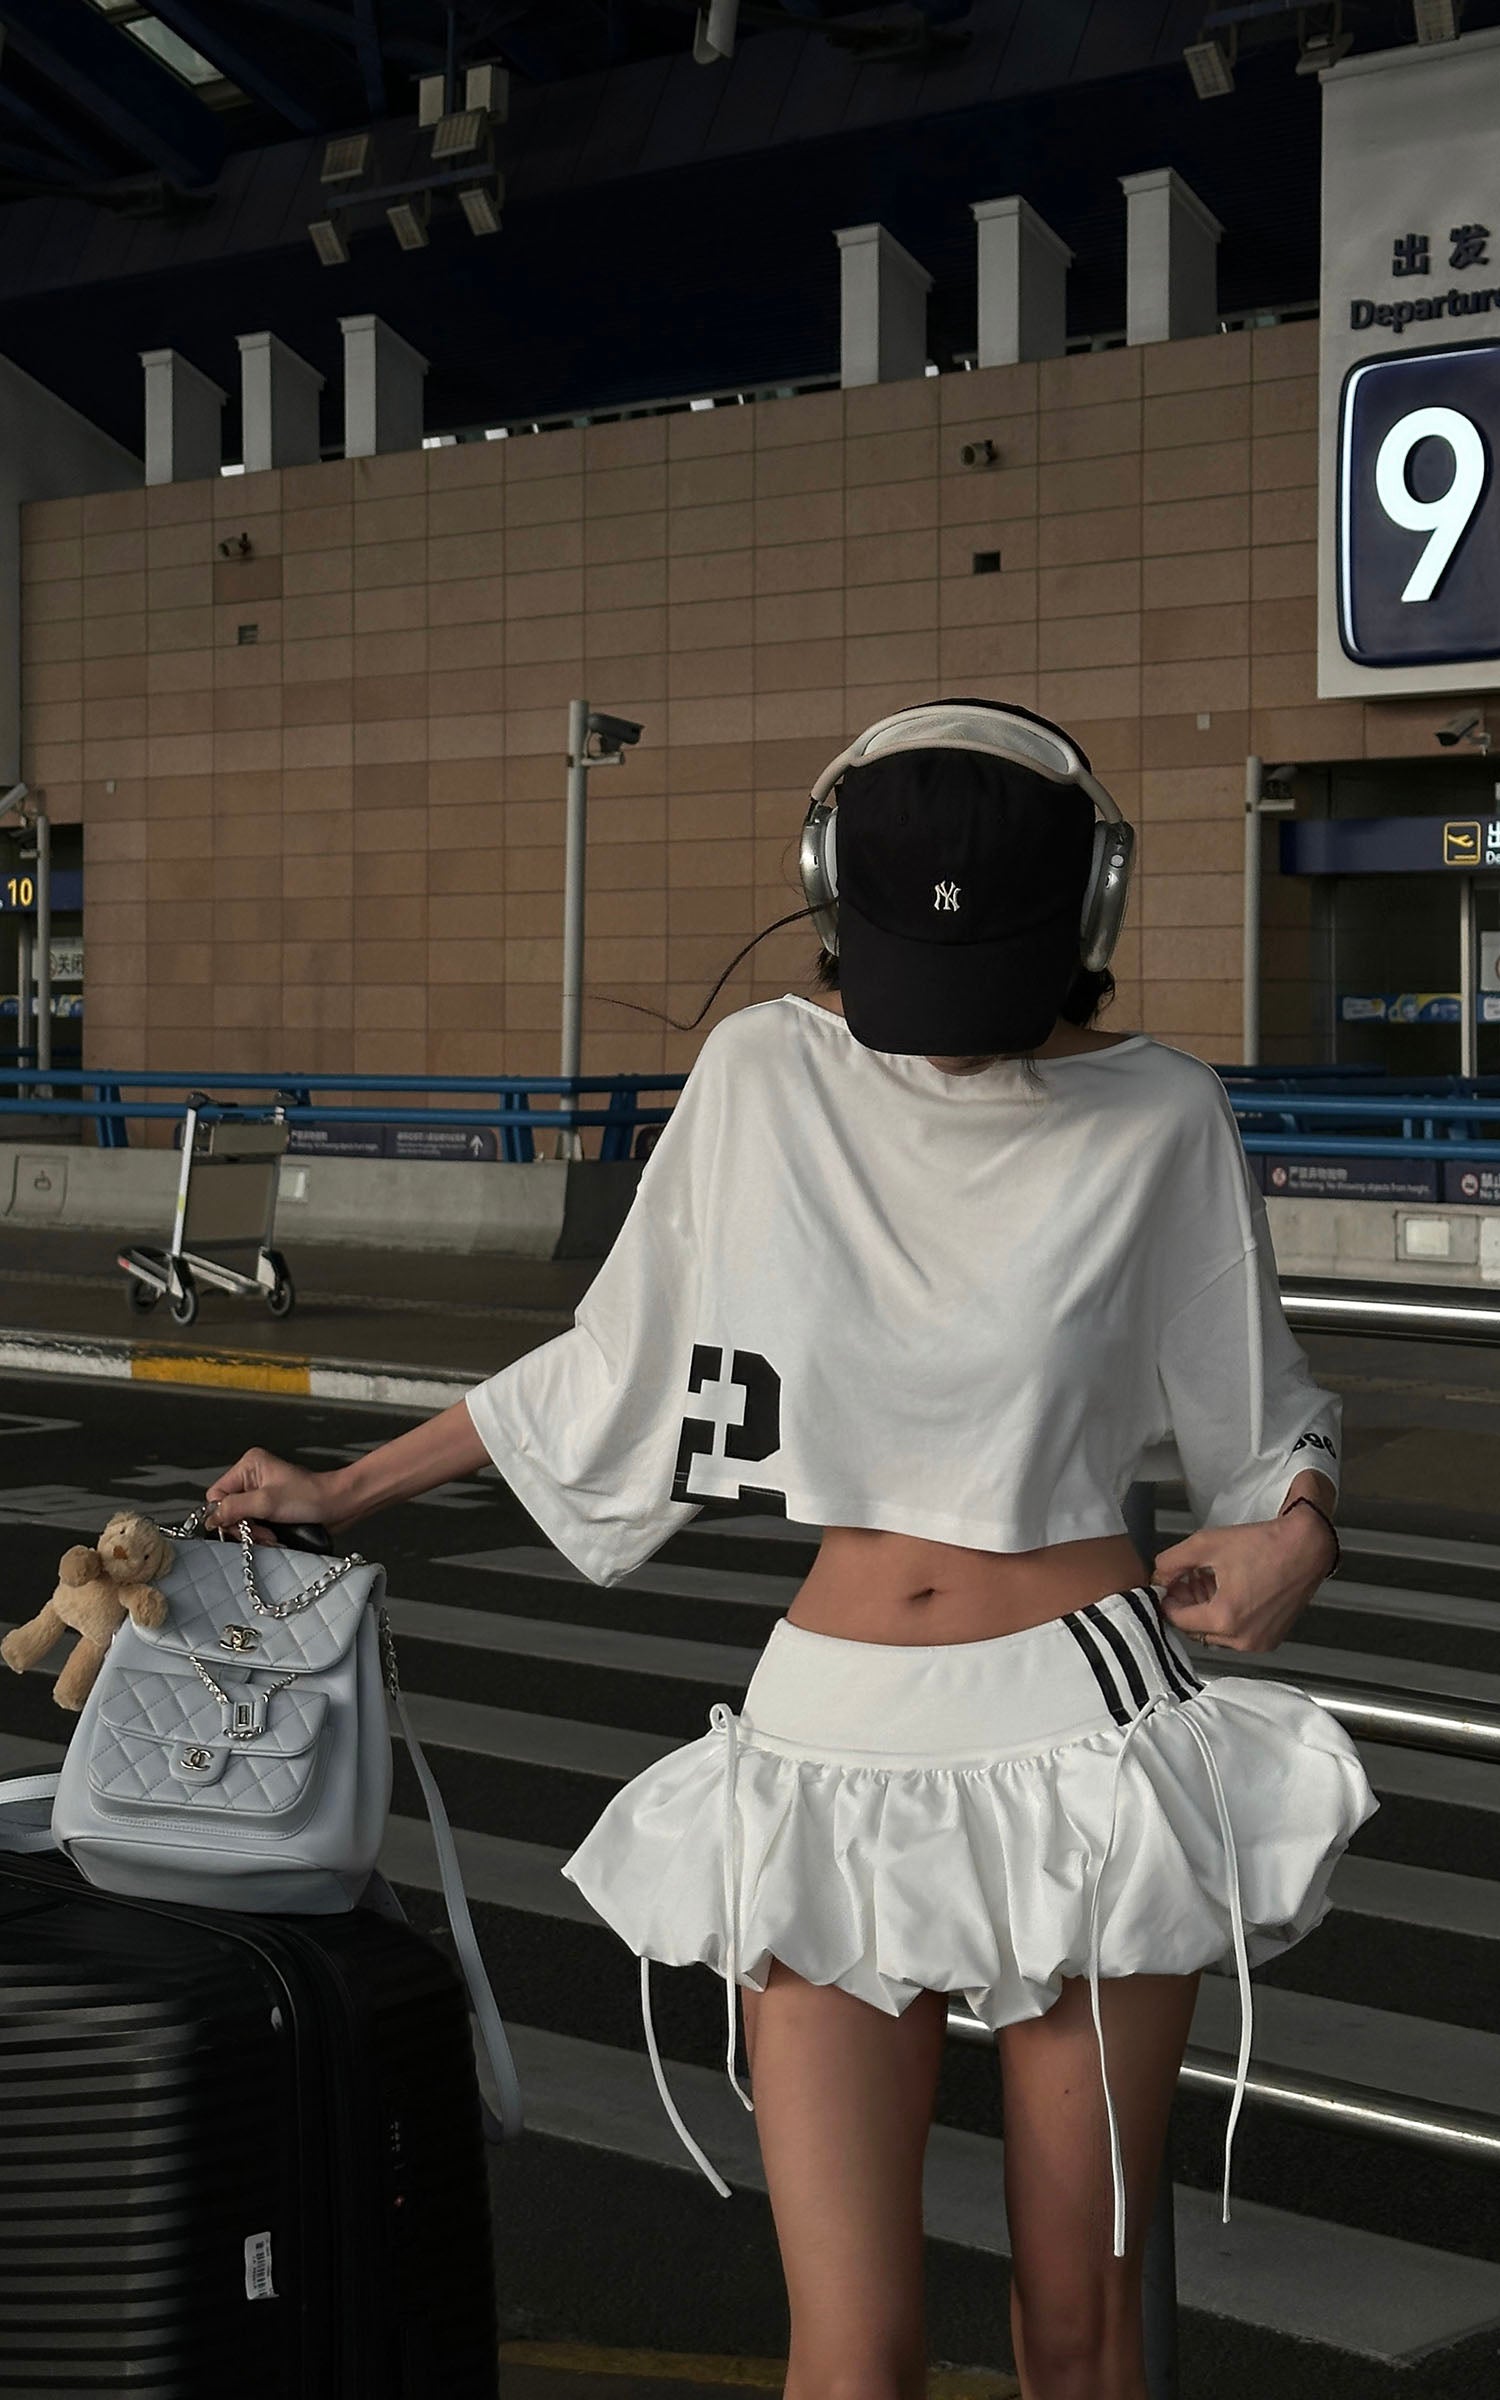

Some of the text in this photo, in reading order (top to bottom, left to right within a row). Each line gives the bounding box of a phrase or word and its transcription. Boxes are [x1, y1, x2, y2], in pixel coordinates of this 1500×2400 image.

[1392, 224, 1490, 277] 出发
[1375, 406, 1485, 602] 9
[8, 877, 34, 907] 10
[670, 1344, 788, 1517] 2
